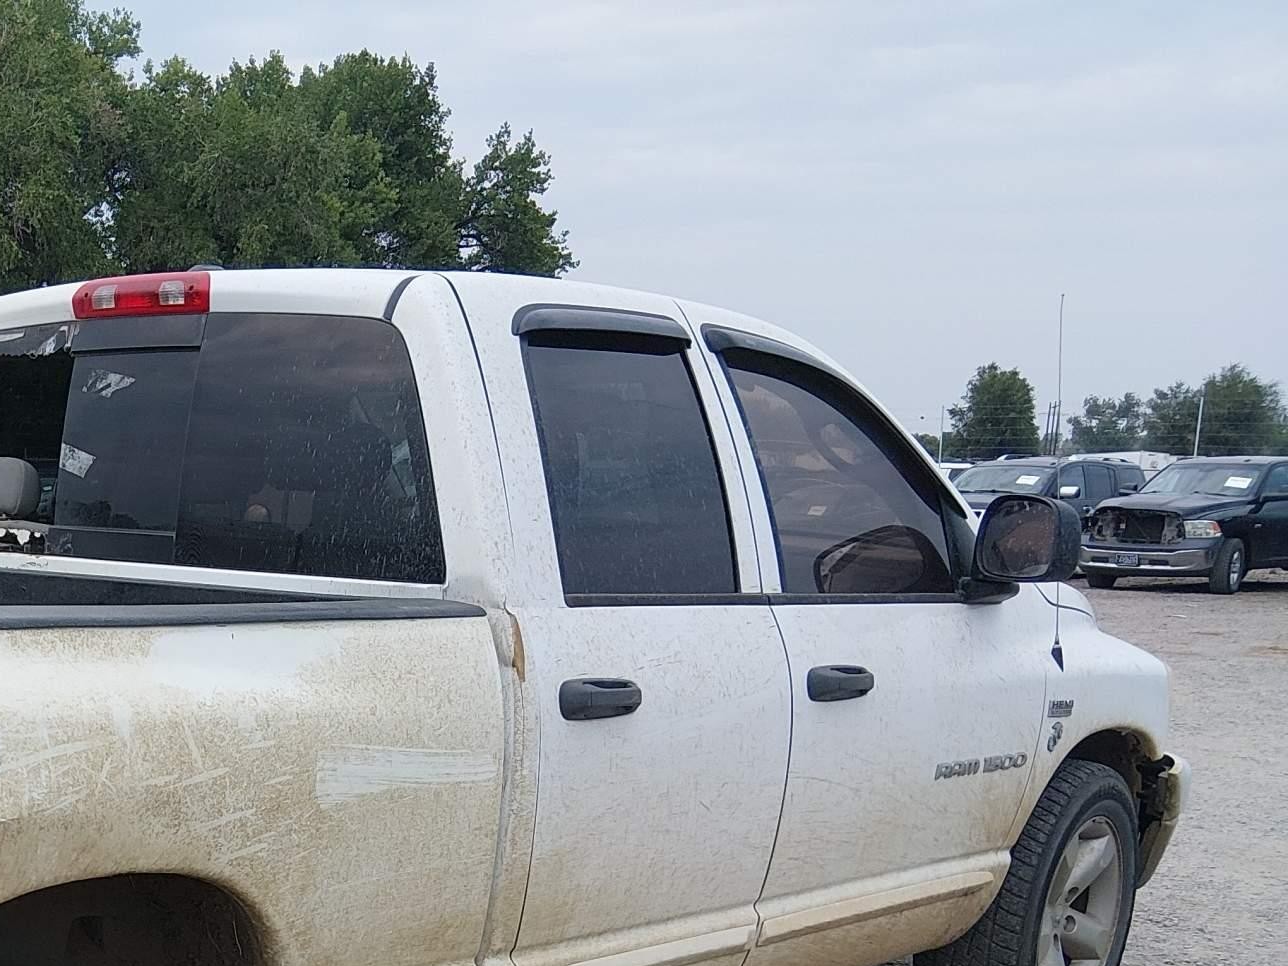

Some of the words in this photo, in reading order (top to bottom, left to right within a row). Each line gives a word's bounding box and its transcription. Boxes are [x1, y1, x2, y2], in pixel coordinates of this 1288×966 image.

[1052, 700, 1074, 710] HEMI
[935, 758, 980, 780] RAM
[983, 752, 1027, 773] 1500
